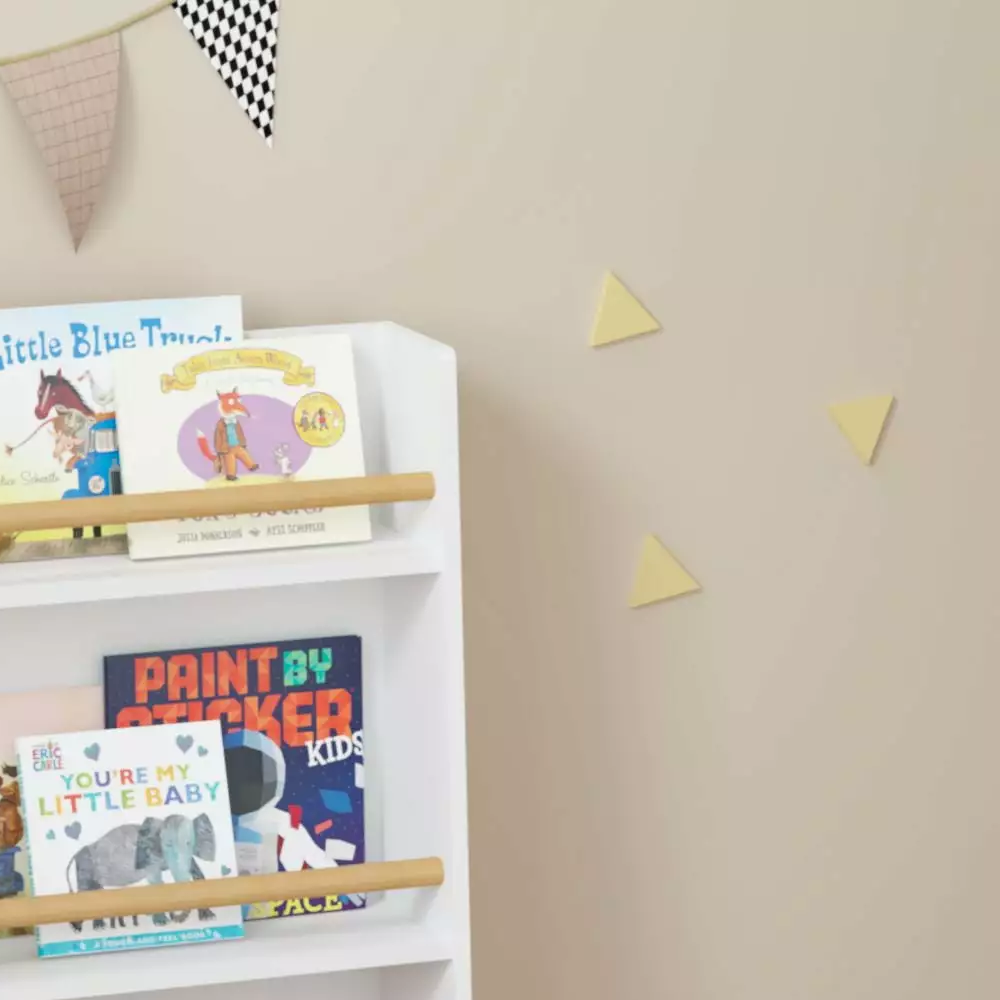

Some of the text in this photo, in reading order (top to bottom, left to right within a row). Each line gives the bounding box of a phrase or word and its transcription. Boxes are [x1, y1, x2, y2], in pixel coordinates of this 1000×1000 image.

[69, 322, 136, 359] Blue
[140, 317, 232, 347] Tru
[134, 646, 333, 704] PAINT BY
[304, 728, 365, 768] KIDS
[60, 764, 190, 791] YOU'RE MY
[38, 781, 221, 817] LITTLE BABY
